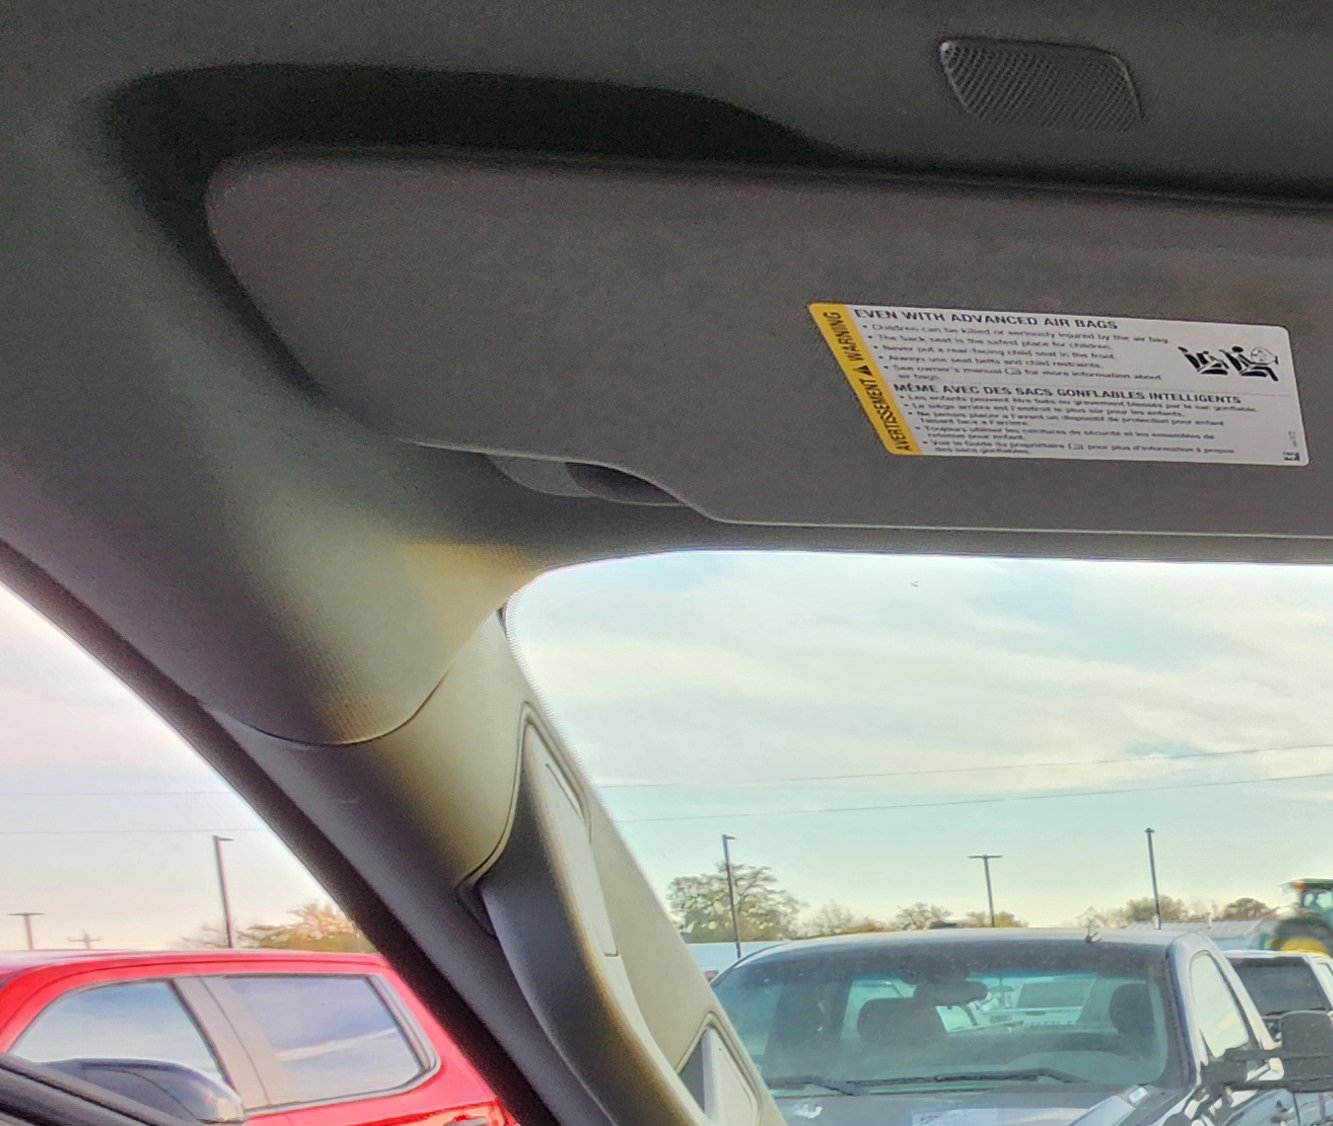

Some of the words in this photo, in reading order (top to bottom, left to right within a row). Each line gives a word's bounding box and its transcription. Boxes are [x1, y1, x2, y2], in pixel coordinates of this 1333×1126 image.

[852, 308, 899, 319] EVEN
[900, 310, 946, 321] WITH
[948, 313, 1039, 325] ADVANCED
[1041, 317, 1070, 327] AIR
[1073, 318, 1118, 329] BAGS
[823, 311, 865, 361] WARNING
[891, 382, 938, 392] MÊME
[940, 384, 980, 394] AVEC
[981, 386, 1012, 395] DES
[1013, 387, 1053, 396] SACS
[1055, 388, 1145, 400] GONFLABLES
[1147, 392, 1241, 403] INTELLIGENTS
